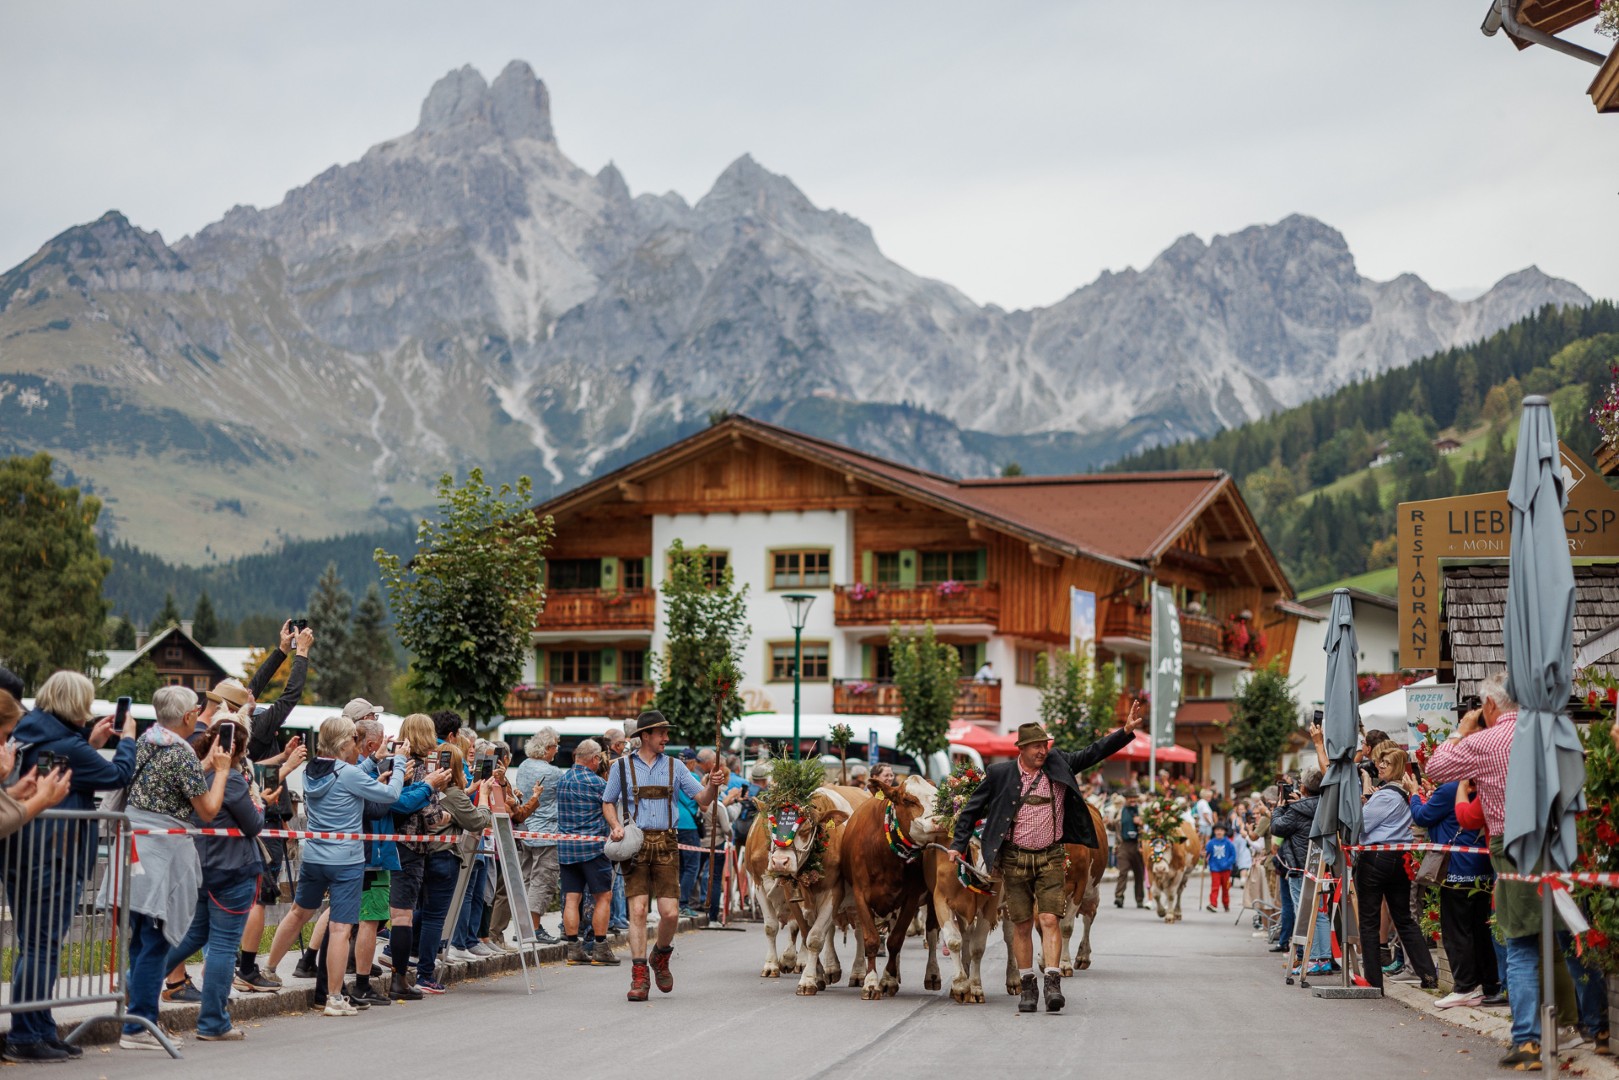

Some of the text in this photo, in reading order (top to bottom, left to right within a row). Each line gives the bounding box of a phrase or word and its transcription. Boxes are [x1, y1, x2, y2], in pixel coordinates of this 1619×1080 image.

[1448, 509, 1616, 534] LIEBGSP
[1410, 510, 1427, 660] RESTAURANT
[1409, 693, 1444, 703] FROZEN
[1419, 702, 1454, 711] YOGURT
